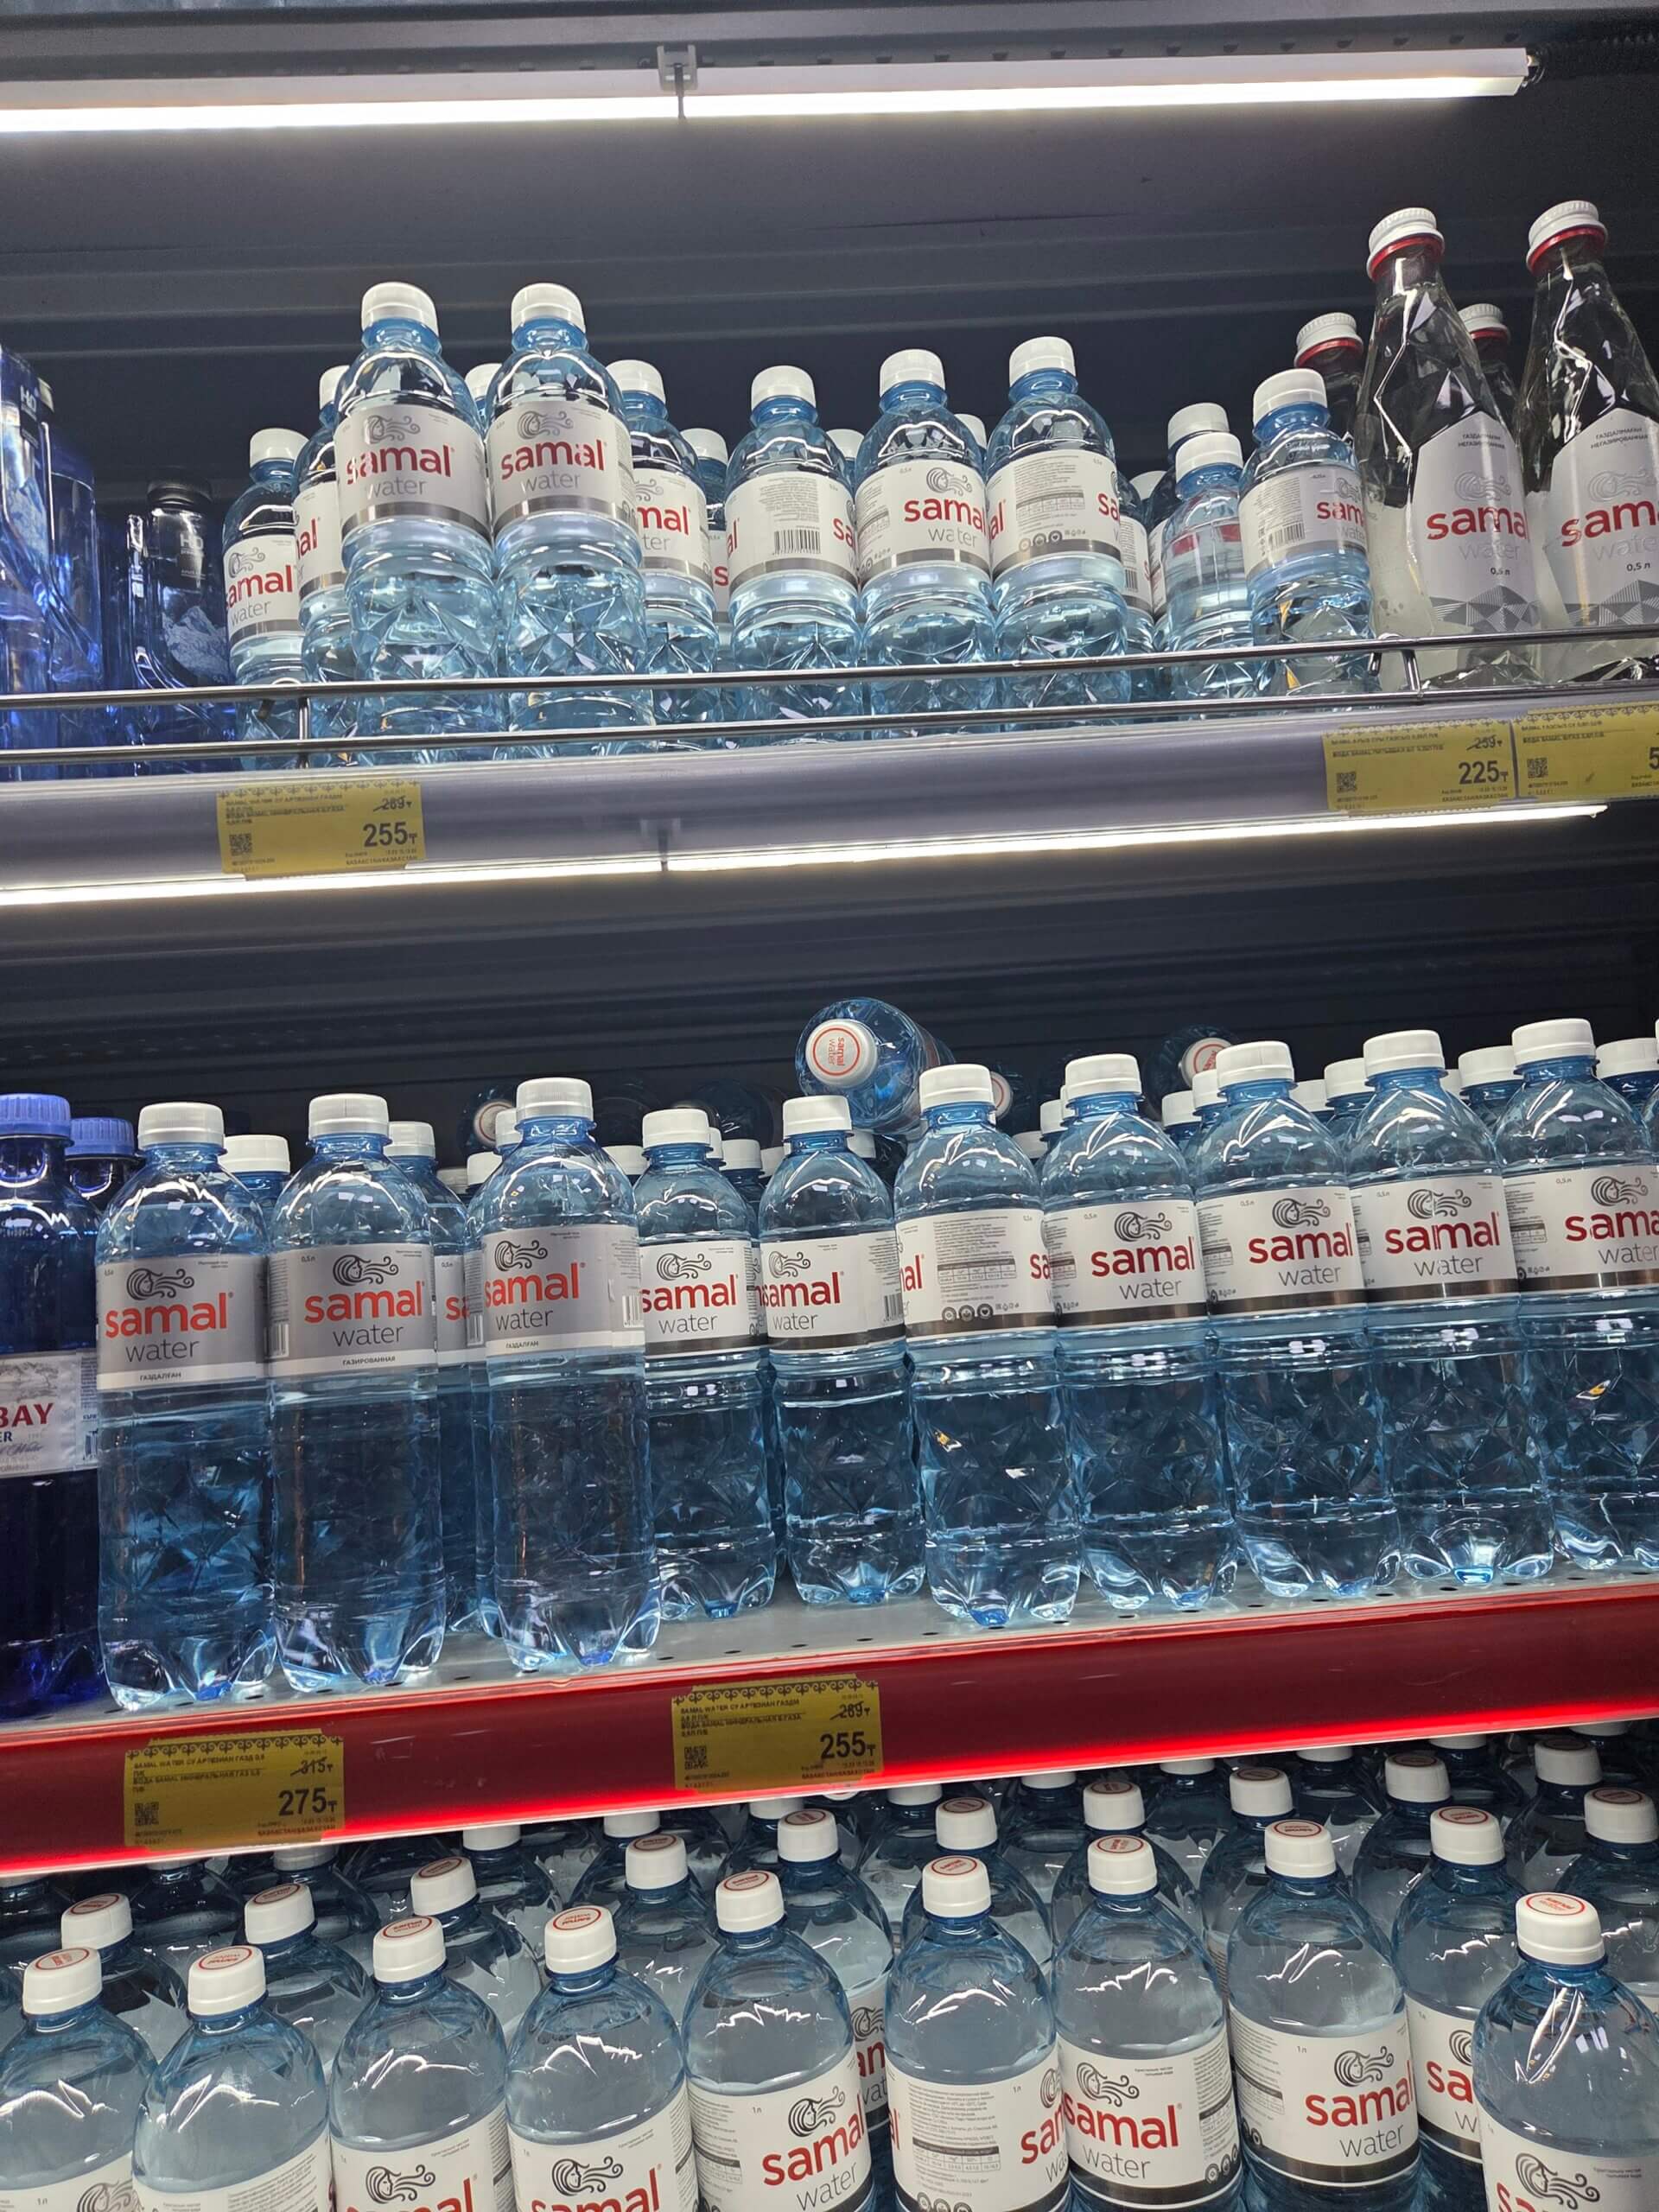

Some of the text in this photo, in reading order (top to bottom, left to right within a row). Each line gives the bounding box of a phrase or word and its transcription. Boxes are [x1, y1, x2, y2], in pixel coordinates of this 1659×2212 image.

[346, 444, 451, 485] samal
[501, 439, 604, 480] samal
[522, 470, 581, 492] water
[1317, 501, 1364, 526] sam
[1560, 500, 1659, 547] sam
[643, 531, 671, 551] ter
[928, 527, 977, 547] water
[1593, 534, 1659, 561] wate
[226, 564, 293, 608] amal
[231, 601, 271, 626] water
[1249, 1223, 1353, 1263] samal
[1385, 1211, 1500, 1254] samal
[1091, 1236, 1195, 1277] samal
[1414, 1255, 1483, 1277] water
[484, 1262, 580, 1308] samal
[763, 1272, 840, 1307] samal
[1119, 1279, 1182, 1300] water
[1279, 1265, 1341, 1287] water
[304, 1281, 423, 1323] samal
[642, 1274, 736, 1313] samal
[105, 1293, 226, 1338] samal
[496, 1308, 554, 1331] water
[658, 1313, 718, 1334] water
[772, 1313, 818, 1332] water
[125, 1339, 200, 1363] water
[333, 1325, 404, 1347] water
[1306, 2060, 1413, 2127] samal
[1064, 2092, 1179, 2149] samal
[762, 2093, 864, 2186] samal
[1339, 2125, 1404, 2158] water
[1083, 2145, 1151, 2179] water
[797, 2162, 856, 2211] water
